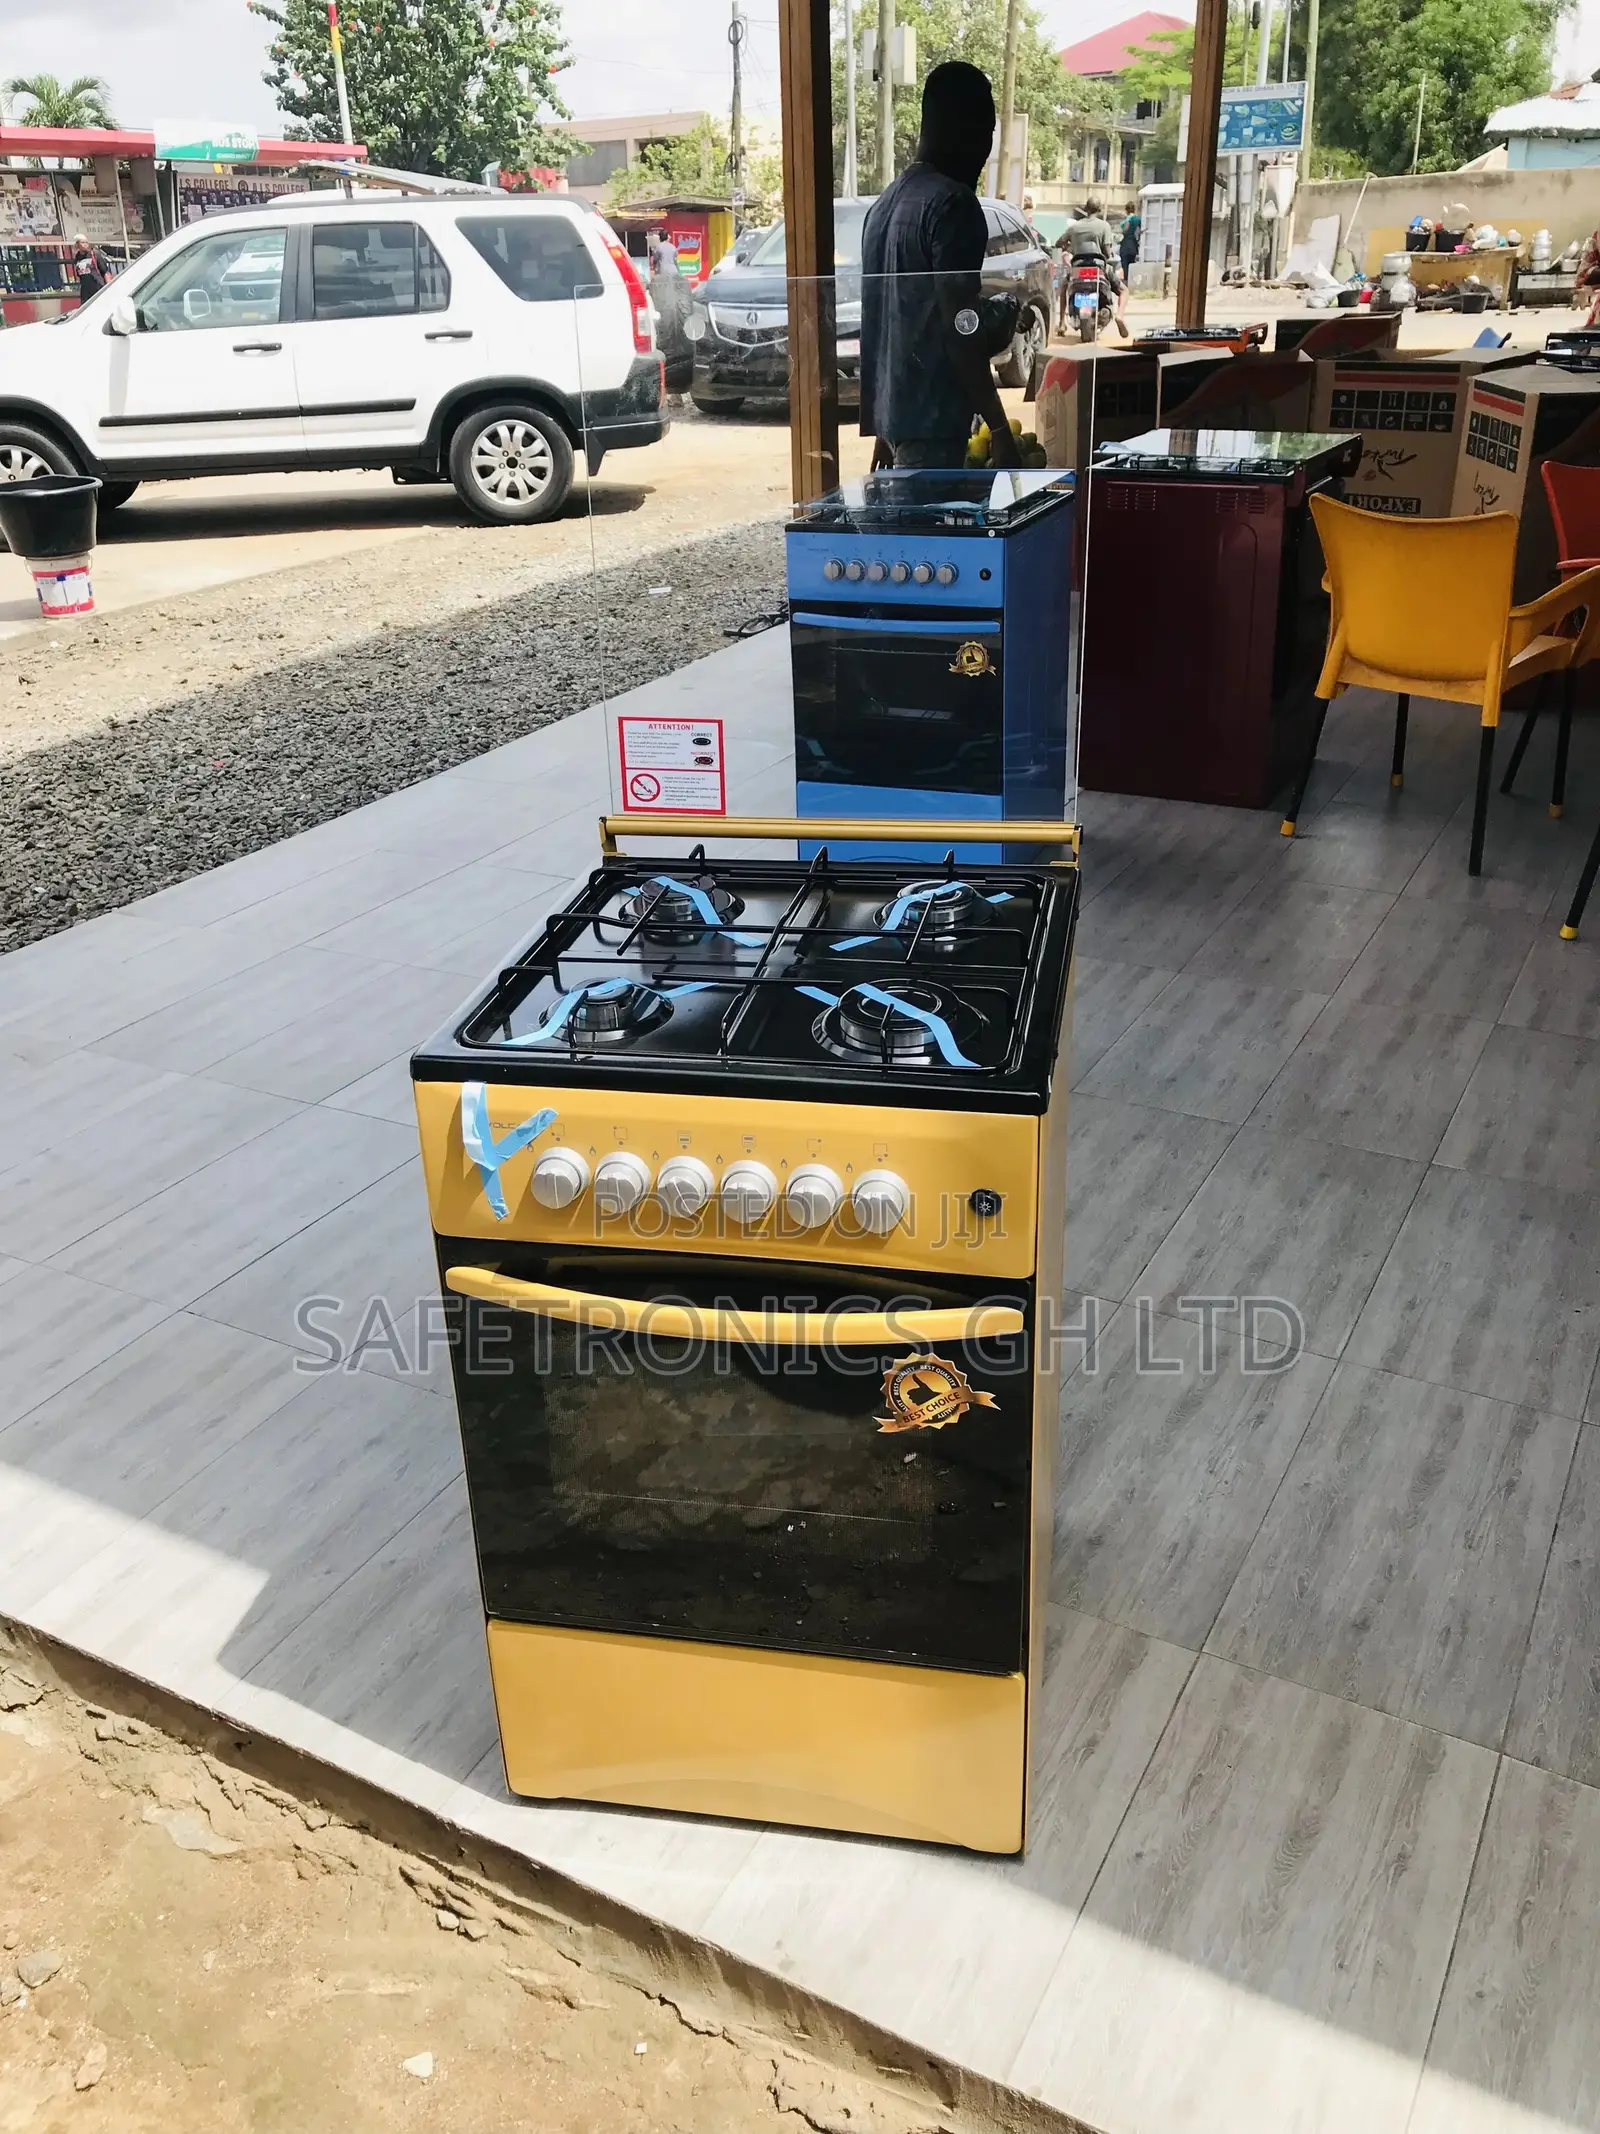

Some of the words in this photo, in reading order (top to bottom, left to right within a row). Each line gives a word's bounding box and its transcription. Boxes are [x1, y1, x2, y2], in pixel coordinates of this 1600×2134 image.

[193, 178, 229, 190] COLLEGE
[272, 183, 305, 194] COLLEGE
[648, 723, 694, 731] ATTENTION!
[896, 1366, 916, 1383] QUALITY
[935, 1367, 957, 1387] QUALITY
[903, 1408, 926, 1423] BEST
[926, 1391, 961, 1412] CHOICE
